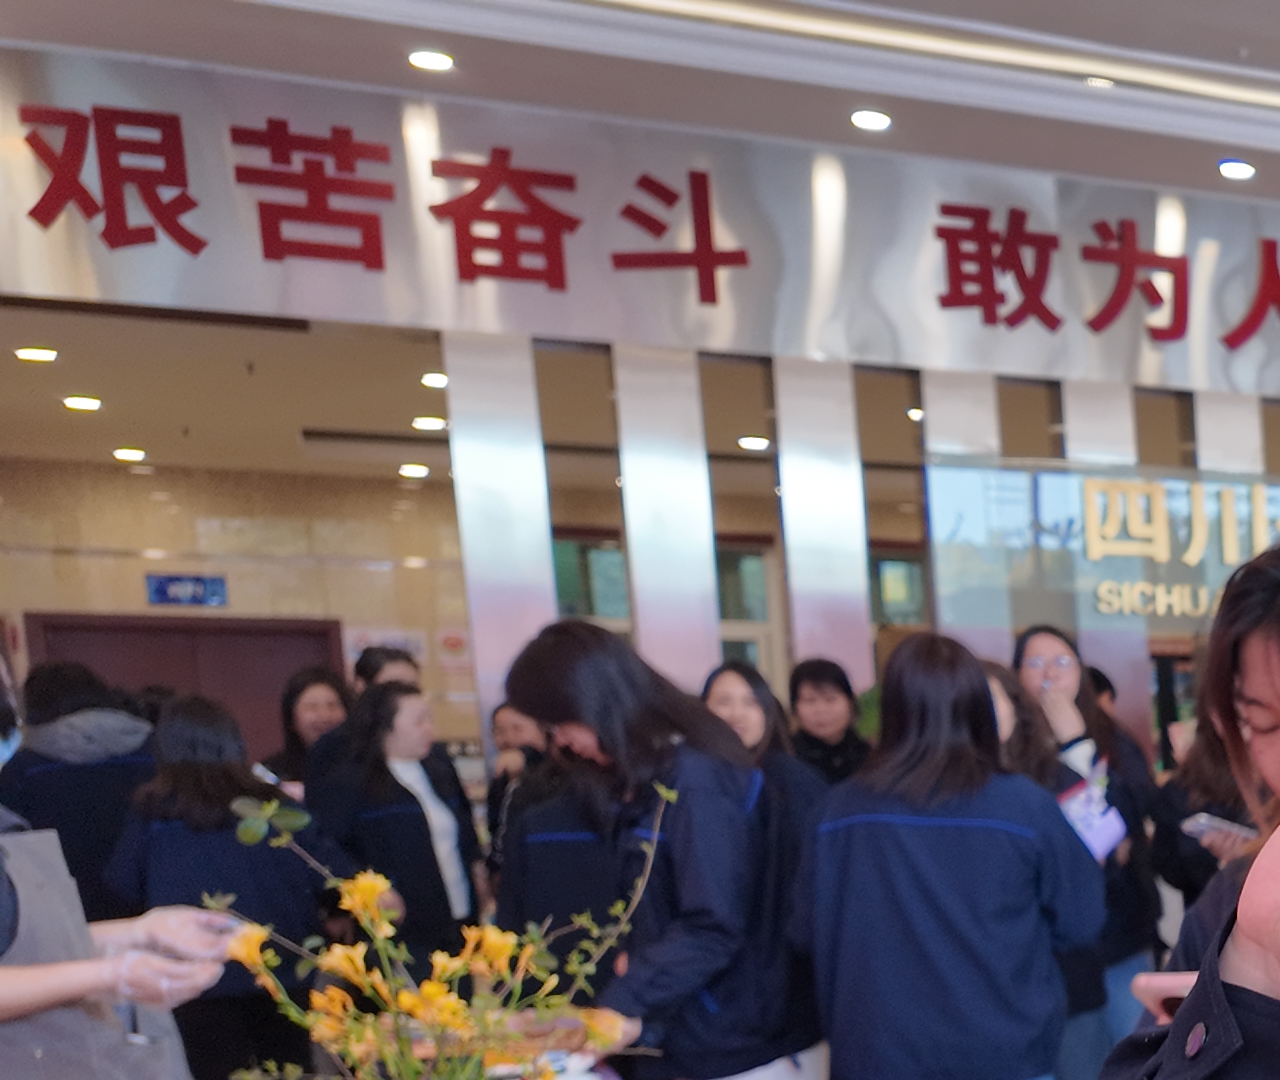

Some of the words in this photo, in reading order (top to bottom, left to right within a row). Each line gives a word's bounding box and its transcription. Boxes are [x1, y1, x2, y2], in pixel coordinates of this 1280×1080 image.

[19, 105, 749, 305] 艰苦奋斗
[1096, 580, 1225, 617] SICHU
